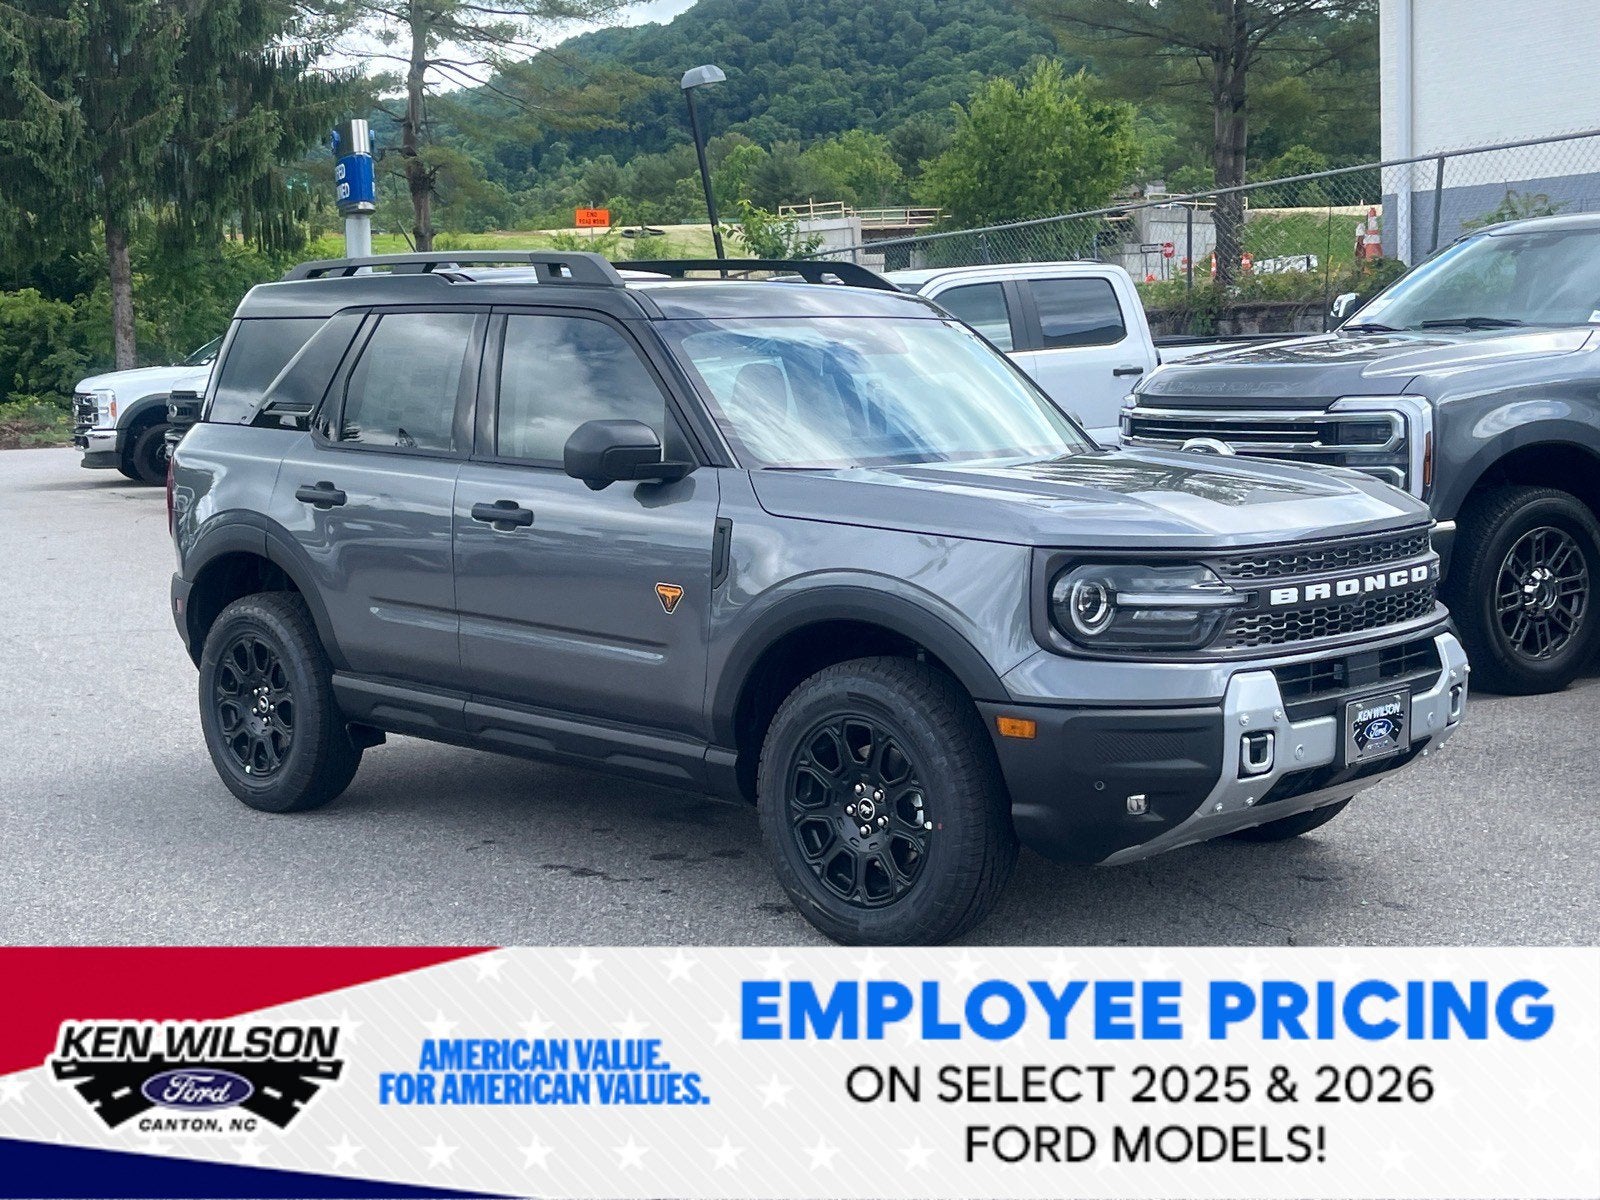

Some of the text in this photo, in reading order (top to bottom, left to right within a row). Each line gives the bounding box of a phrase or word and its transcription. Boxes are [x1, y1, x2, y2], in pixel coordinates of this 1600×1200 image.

[1270, 565, 1428, 606] BRONCO
[1357, 701, 1401, 722] KEN WILSON
